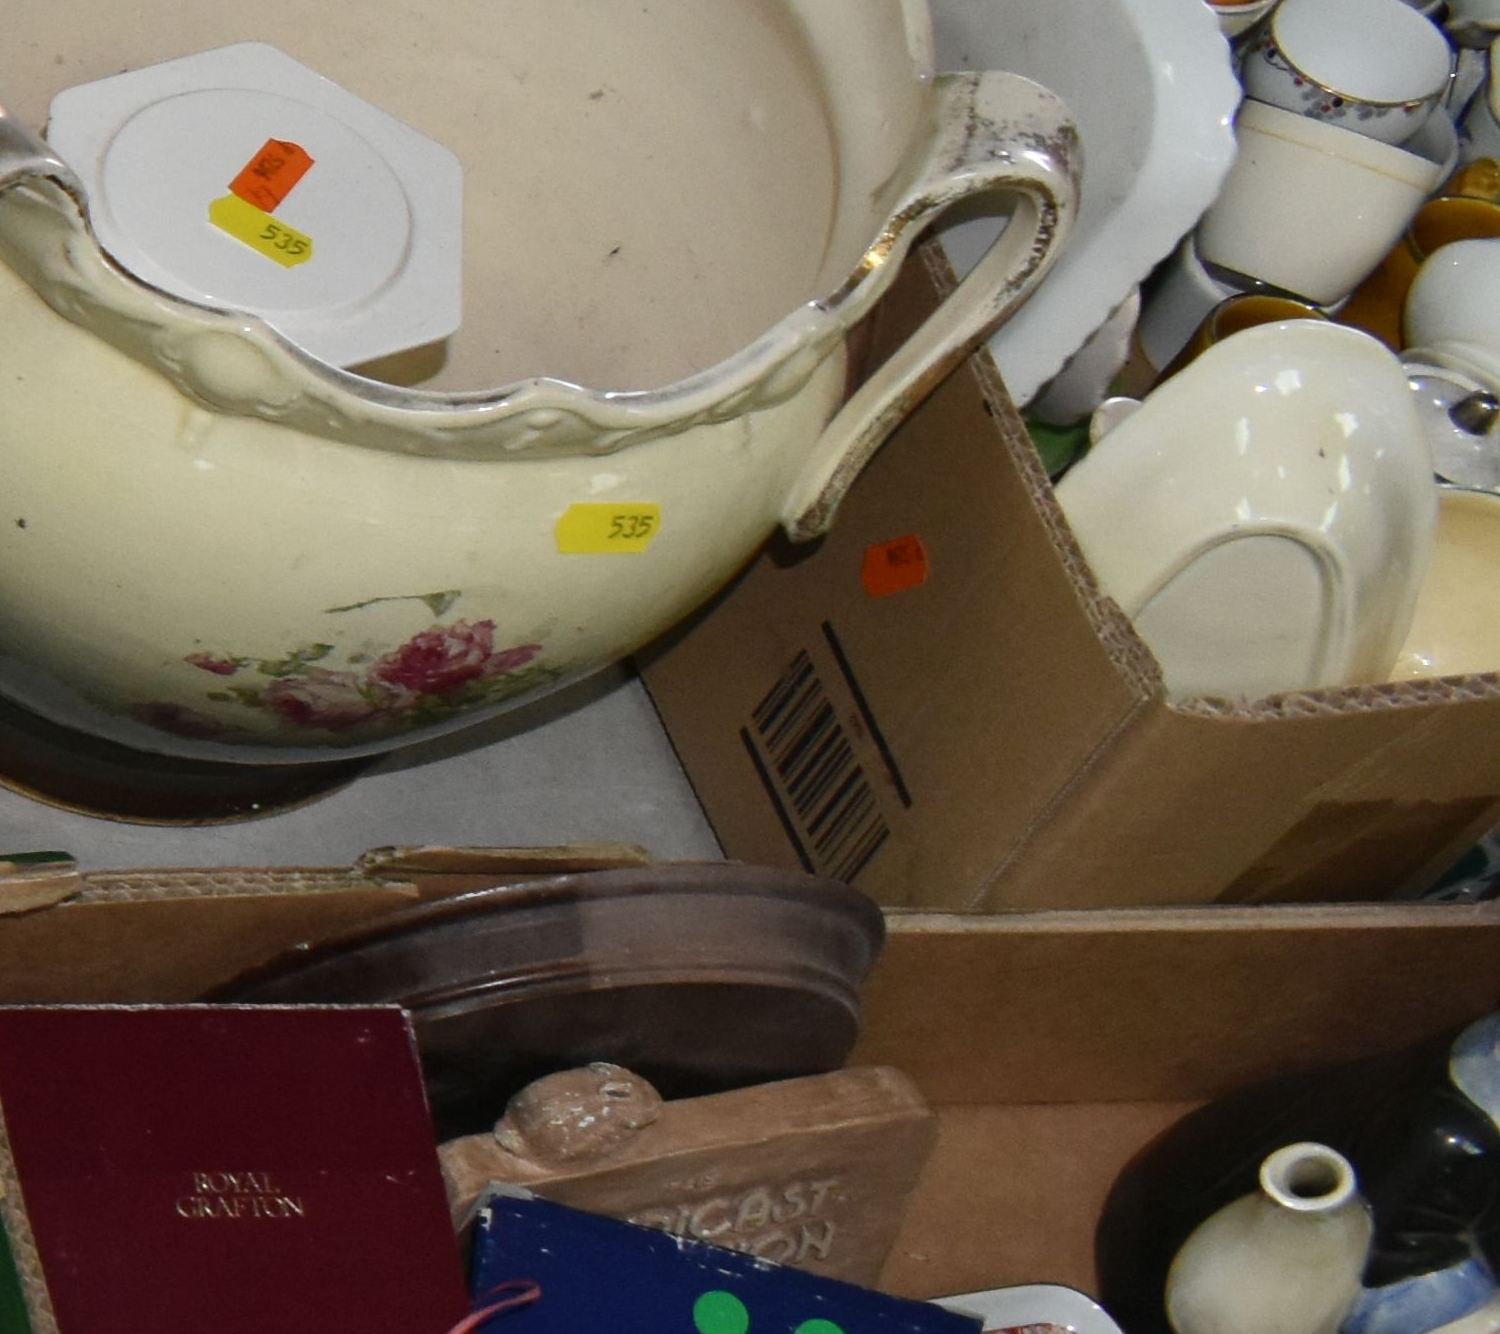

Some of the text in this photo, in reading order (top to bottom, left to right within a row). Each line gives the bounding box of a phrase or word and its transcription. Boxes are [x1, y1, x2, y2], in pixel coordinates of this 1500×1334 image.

[260, 223, 309, 255] 535
[607, 514, 654, 539] 535
[192, 1171, 281, 1194] ROYAL
[176, 1196, 304, 1218] GRAFTON
